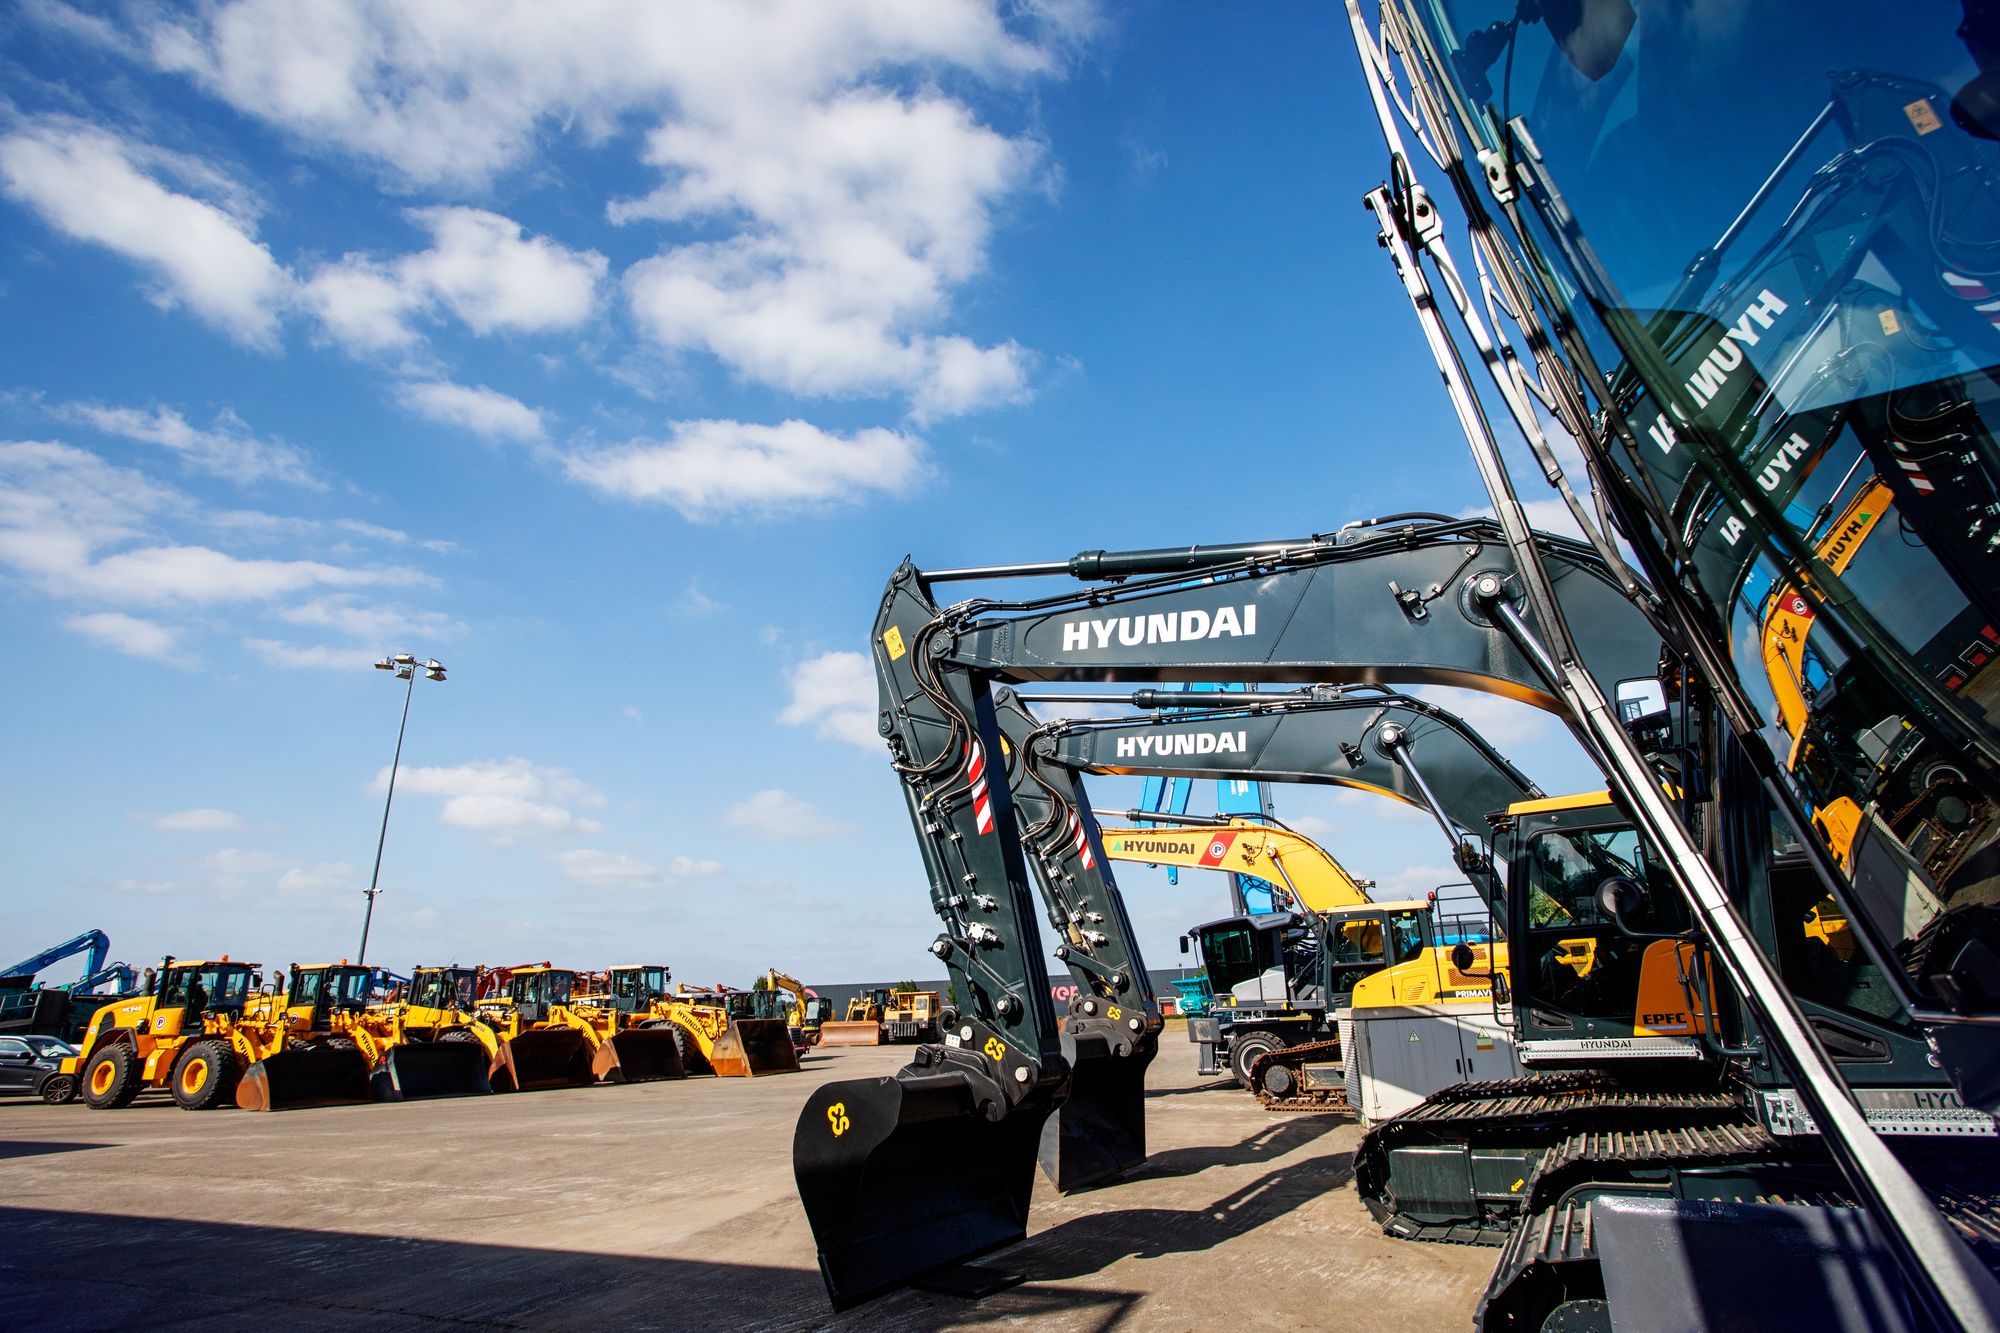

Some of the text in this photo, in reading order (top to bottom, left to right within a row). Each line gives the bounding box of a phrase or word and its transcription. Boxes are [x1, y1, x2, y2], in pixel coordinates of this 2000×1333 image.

[1063, 604, 1256, 651] HYUNDAI
[1117, 731, 1246, 757] HYUNDAI
[1124, 841, 1195, 854] HYUNDAI
[677, 1011, 704, 1036] HYUNDAI
[1643, 1012, 1687, 1025] EPFC
[1580, 1040, 1632, 1049] HYUNDAI
